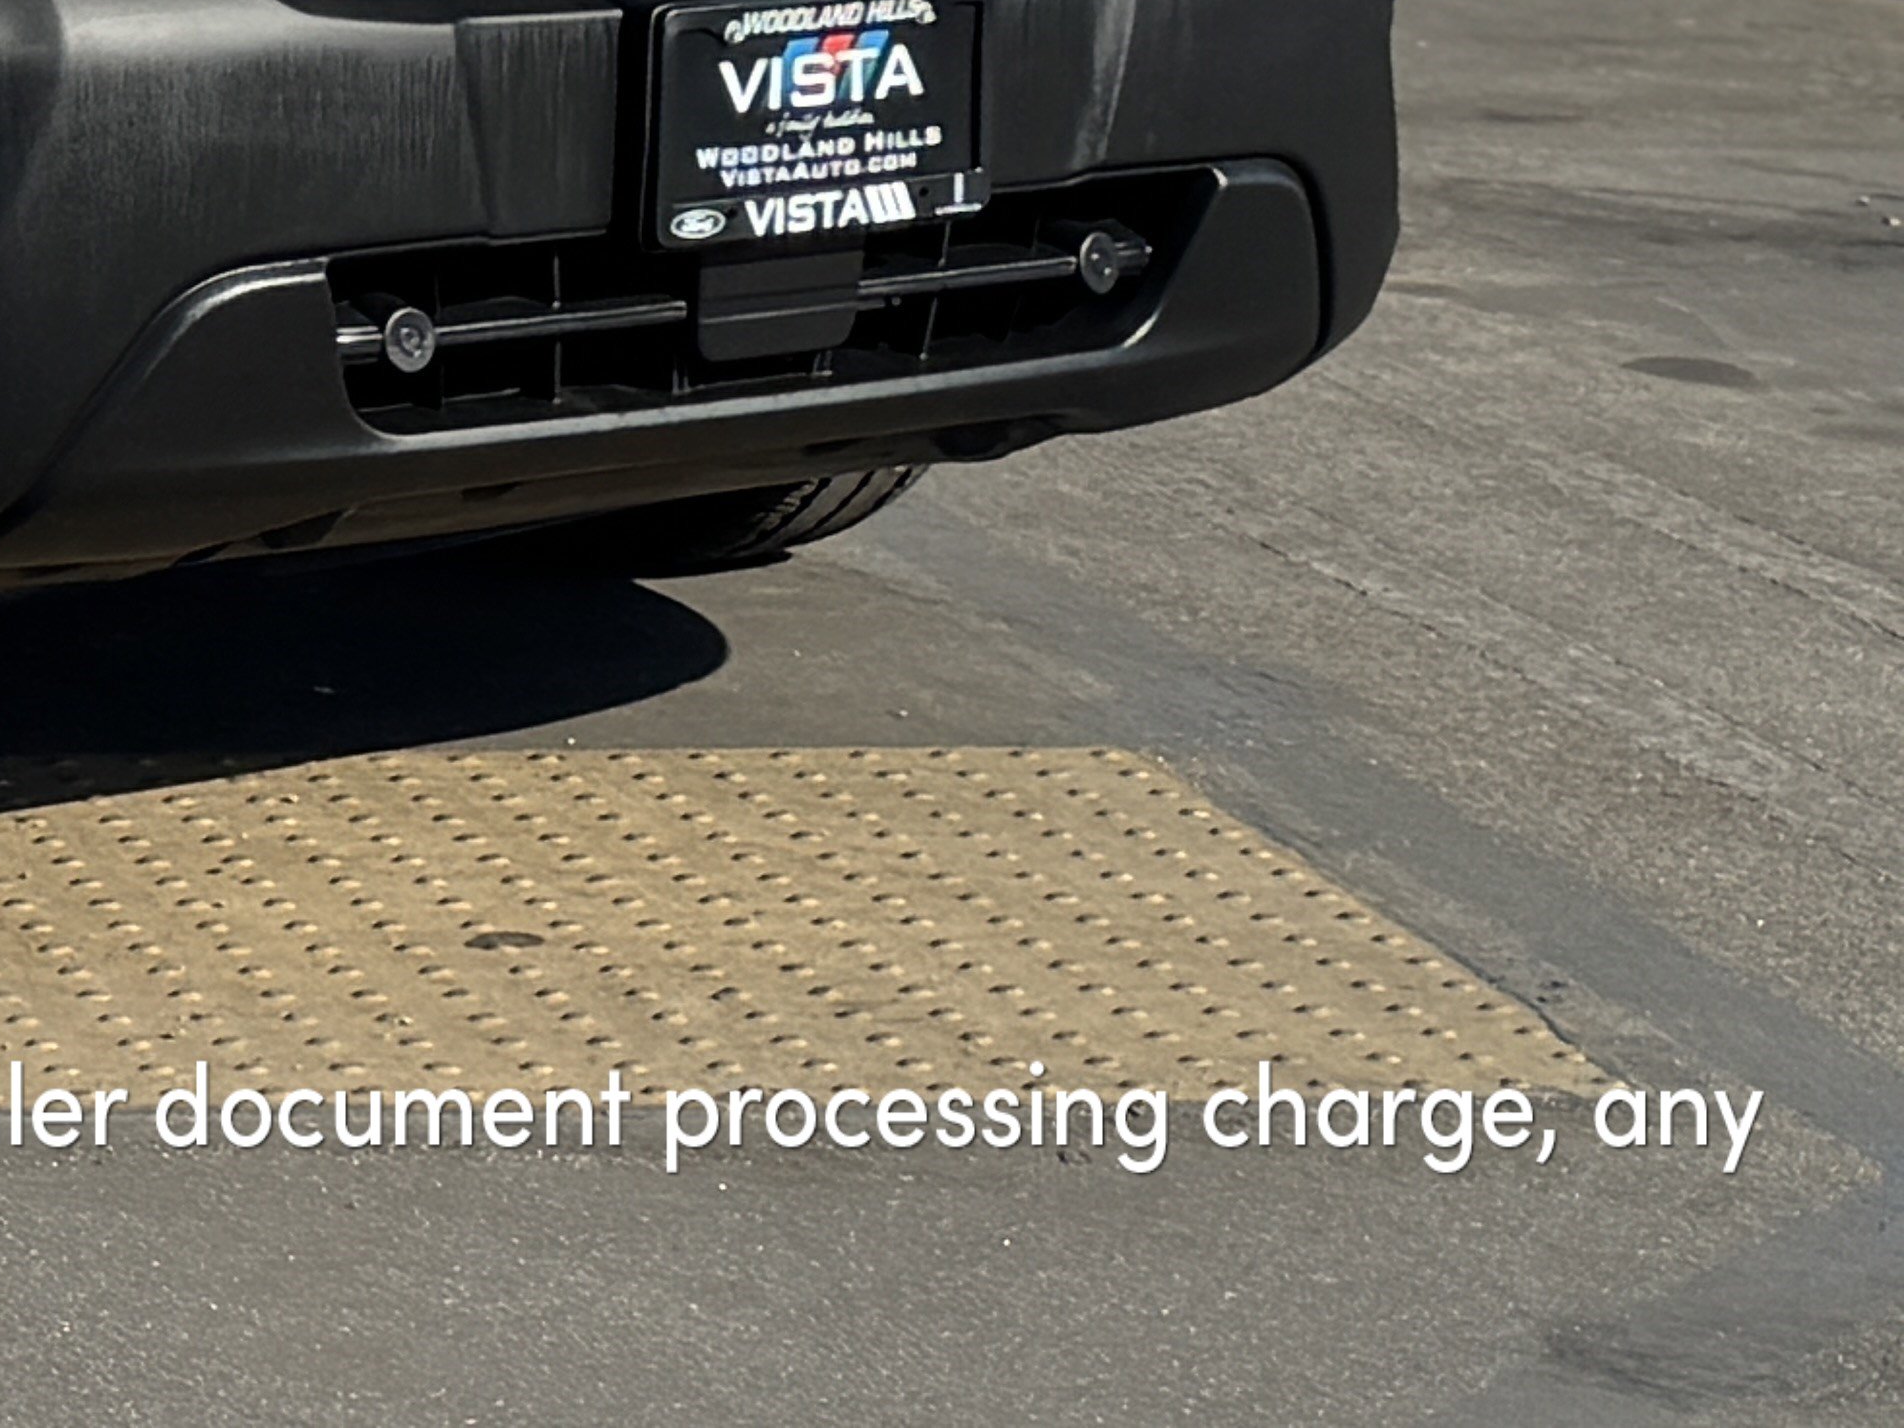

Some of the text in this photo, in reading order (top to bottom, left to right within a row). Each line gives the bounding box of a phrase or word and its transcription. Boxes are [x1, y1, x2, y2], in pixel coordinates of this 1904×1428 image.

[742, 1, 865, 35] WOODLAND
[718, 43, 925, 114] VISTA
[696, 125, 942, 170] WOODLAND HILLS
[744, 187, 869, 237] VISTA
